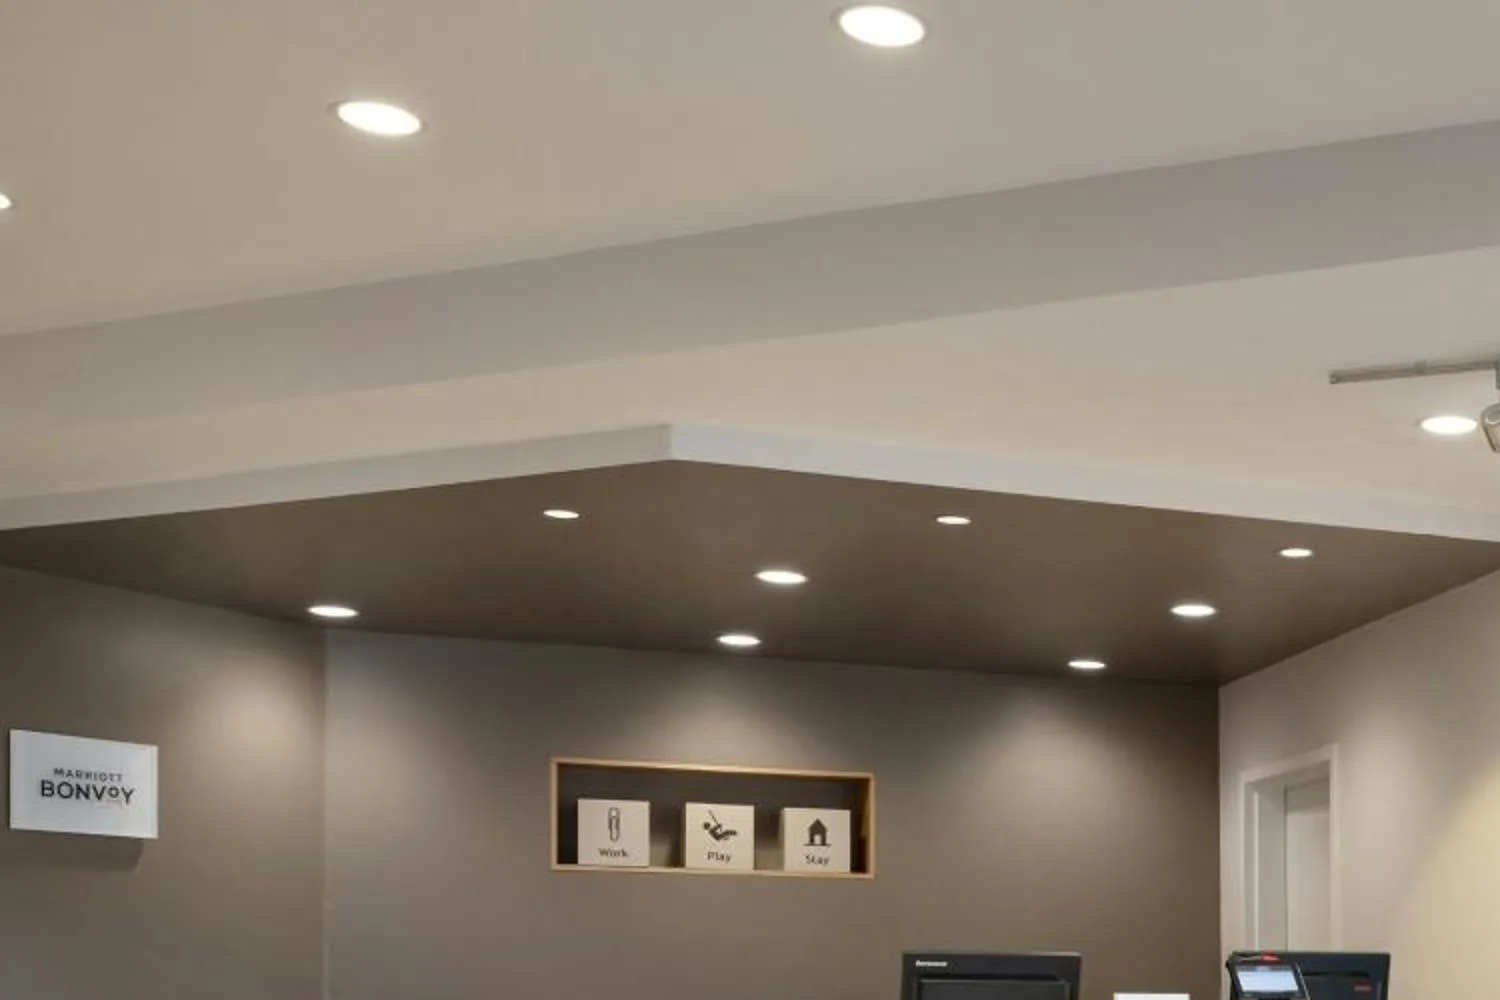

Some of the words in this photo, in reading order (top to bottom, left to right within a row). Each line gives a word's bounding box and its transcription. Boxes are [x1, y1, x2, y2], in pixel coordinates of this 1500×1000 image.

[53, 767, 124, 782] MARRIOTT
[40, 779, 136, 805] BONVOY
[707, 851, 733, 863] Play
[805, 854, 830, 866] Stay
